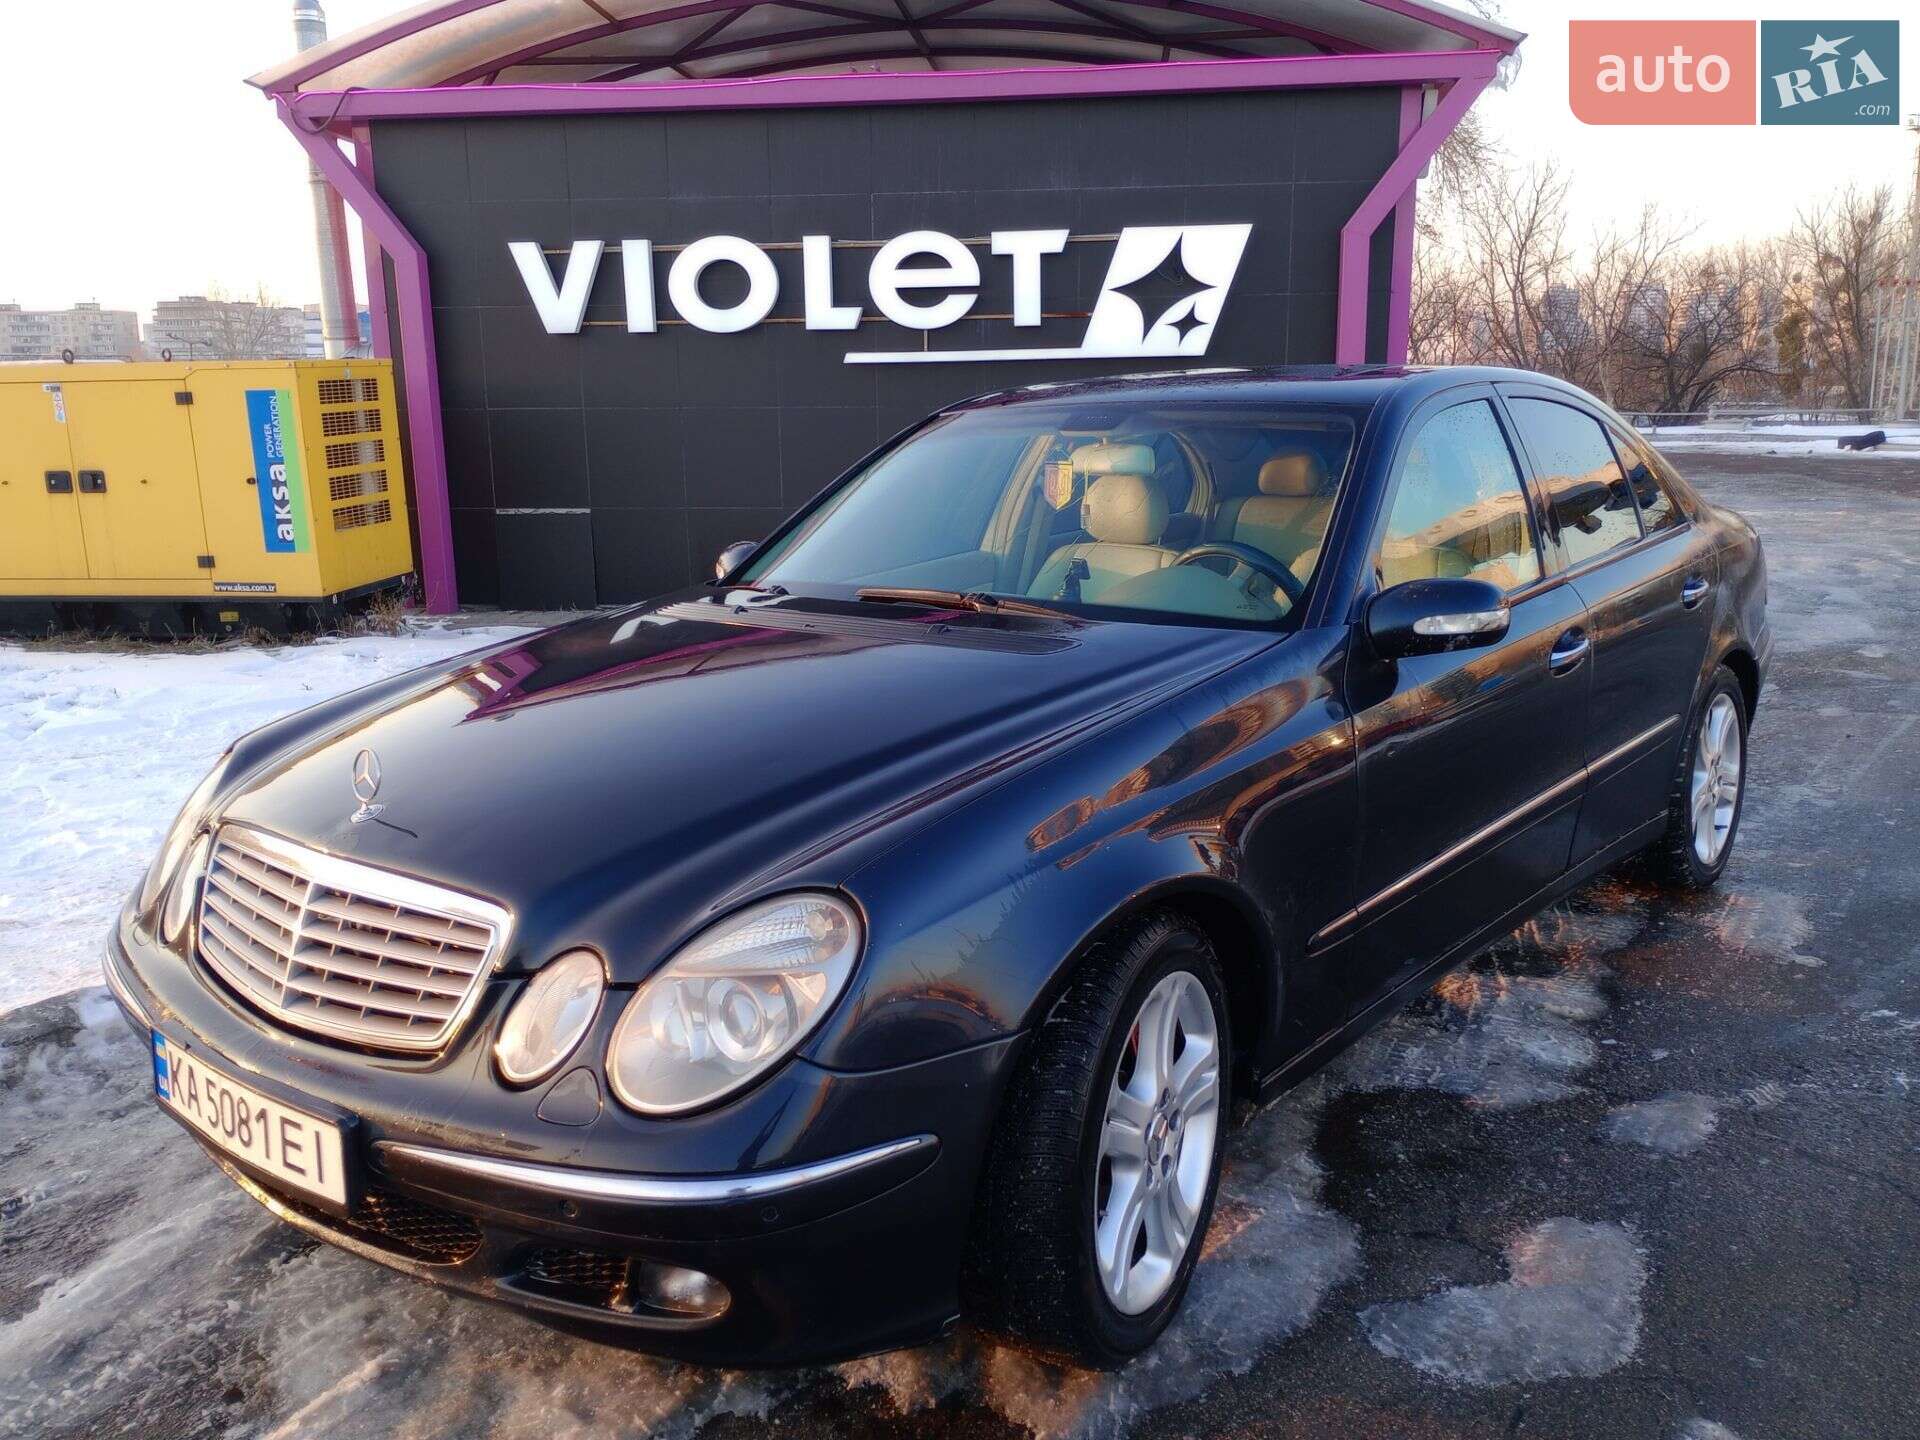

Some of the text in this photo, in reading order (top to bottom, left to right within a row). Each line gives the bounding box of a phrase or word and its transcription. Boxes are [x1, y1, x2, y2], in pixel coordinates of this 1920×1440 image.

[263, 423, 275, 458] POWER
[269, 395, 284, 458] GENERATION
[214, 583, 276, 592] www.aksa.com.tr
